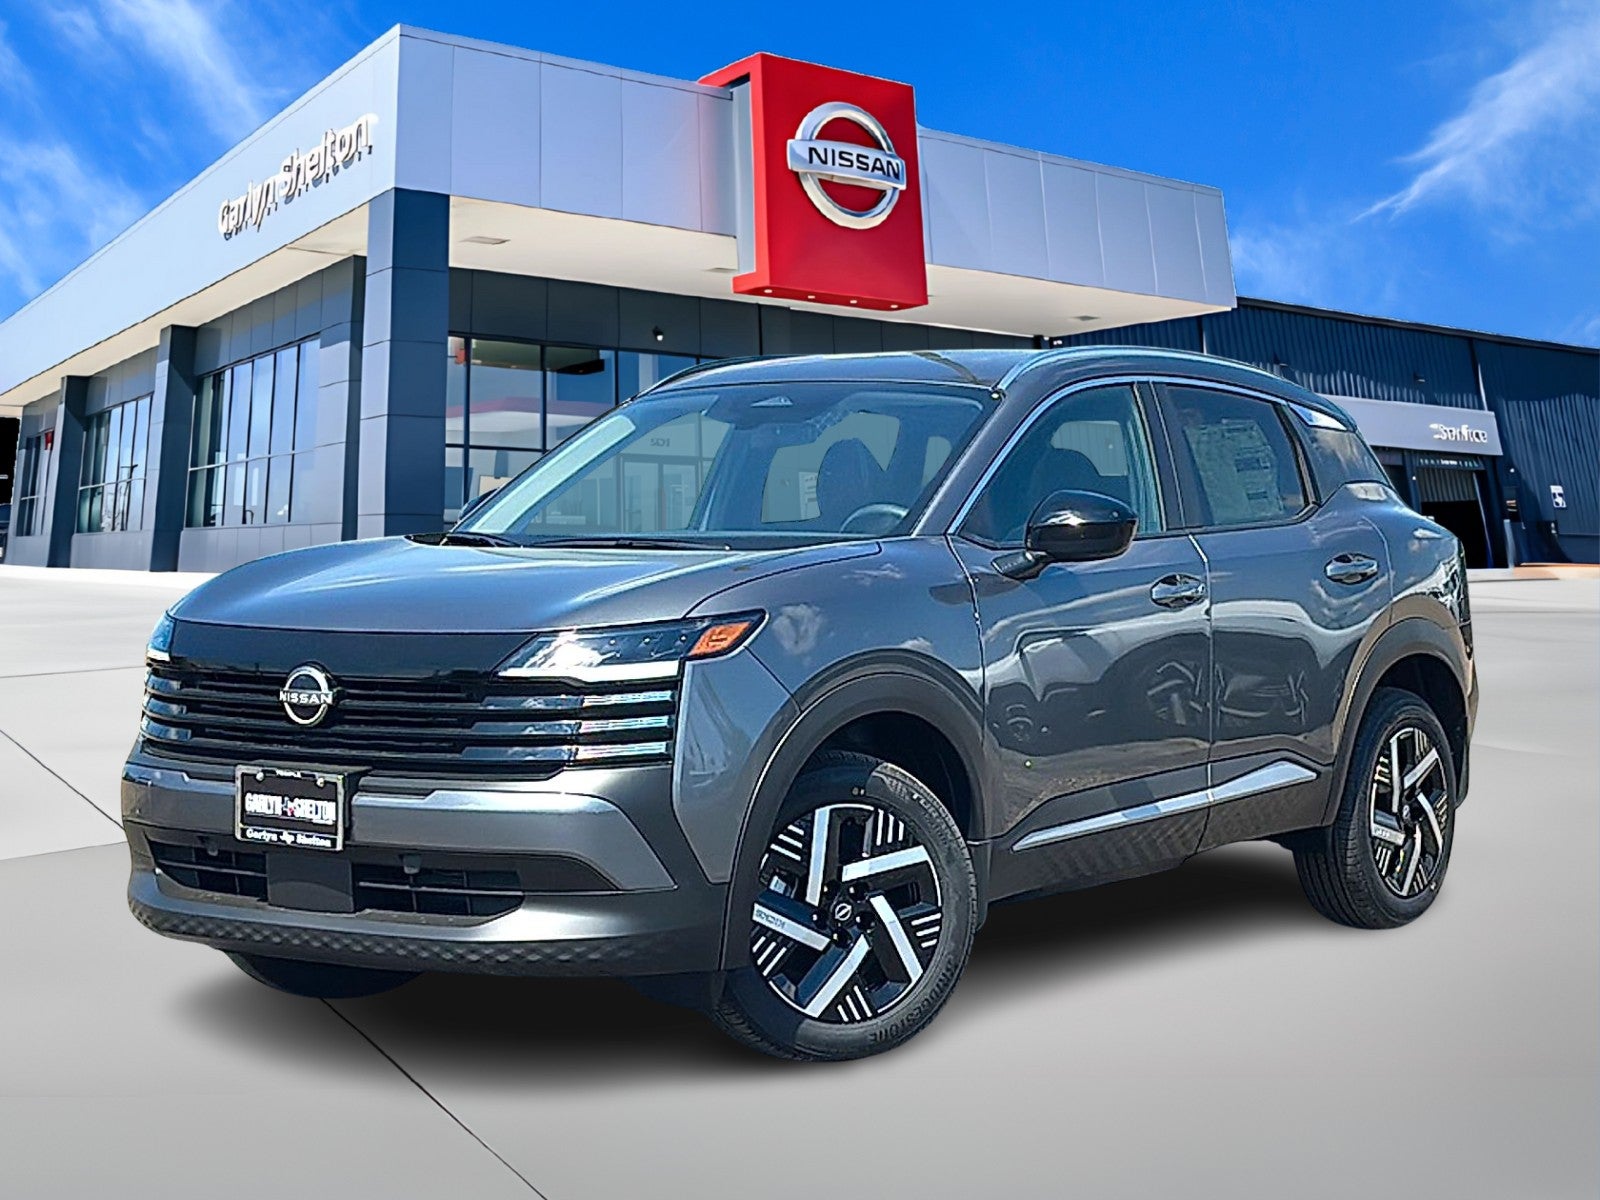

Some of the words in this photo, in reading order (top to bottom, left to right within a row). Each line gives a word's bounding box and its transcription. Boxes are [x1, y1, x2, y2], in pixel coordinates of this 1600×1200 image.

[279, 118, 375, 201] Shelton
[808, 146, 900, 181] NISSAN
[280, 690, 333, 705] NISSAN
